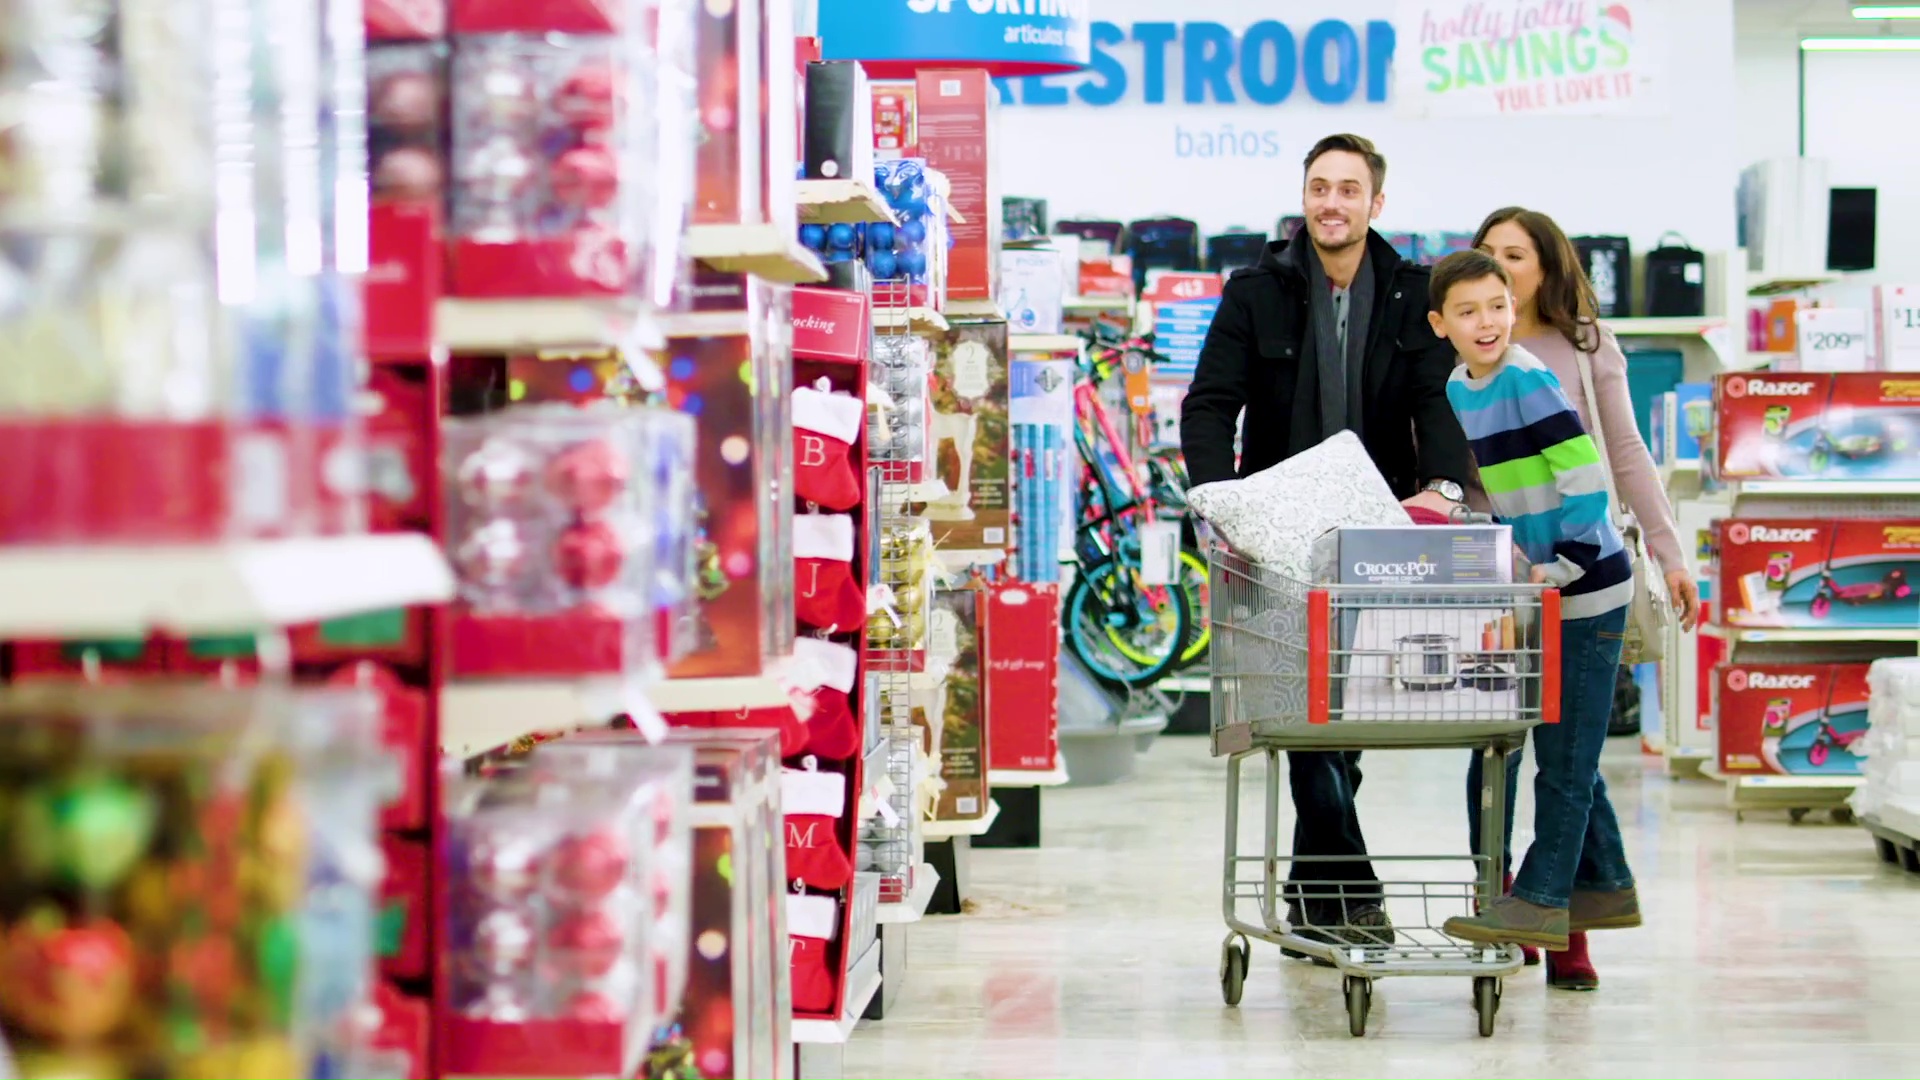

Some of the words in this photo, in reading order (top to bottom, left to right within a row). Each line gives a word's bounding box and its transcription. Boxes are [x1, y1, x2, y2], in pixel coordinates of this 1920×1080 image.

[1421, 26, 1630, 93] SAVINGS
[1495, 84, 1546, 112] YULE
[1555, 74, 1608, 104] LOVE
[1614, 72, 1634, 98] IT
[1175, 122, 1280, 158] baños
[790, 315, 836, 335] ocking
[1747, 379, 1816, 396] Razor
[800, 435, 826, 466] B
[1750, 525, 1819, 543] Razor
[802, 562, 822, 598] J
[1748, 672, 1816, 689] Razor
[786, 822, 819, 849] M
